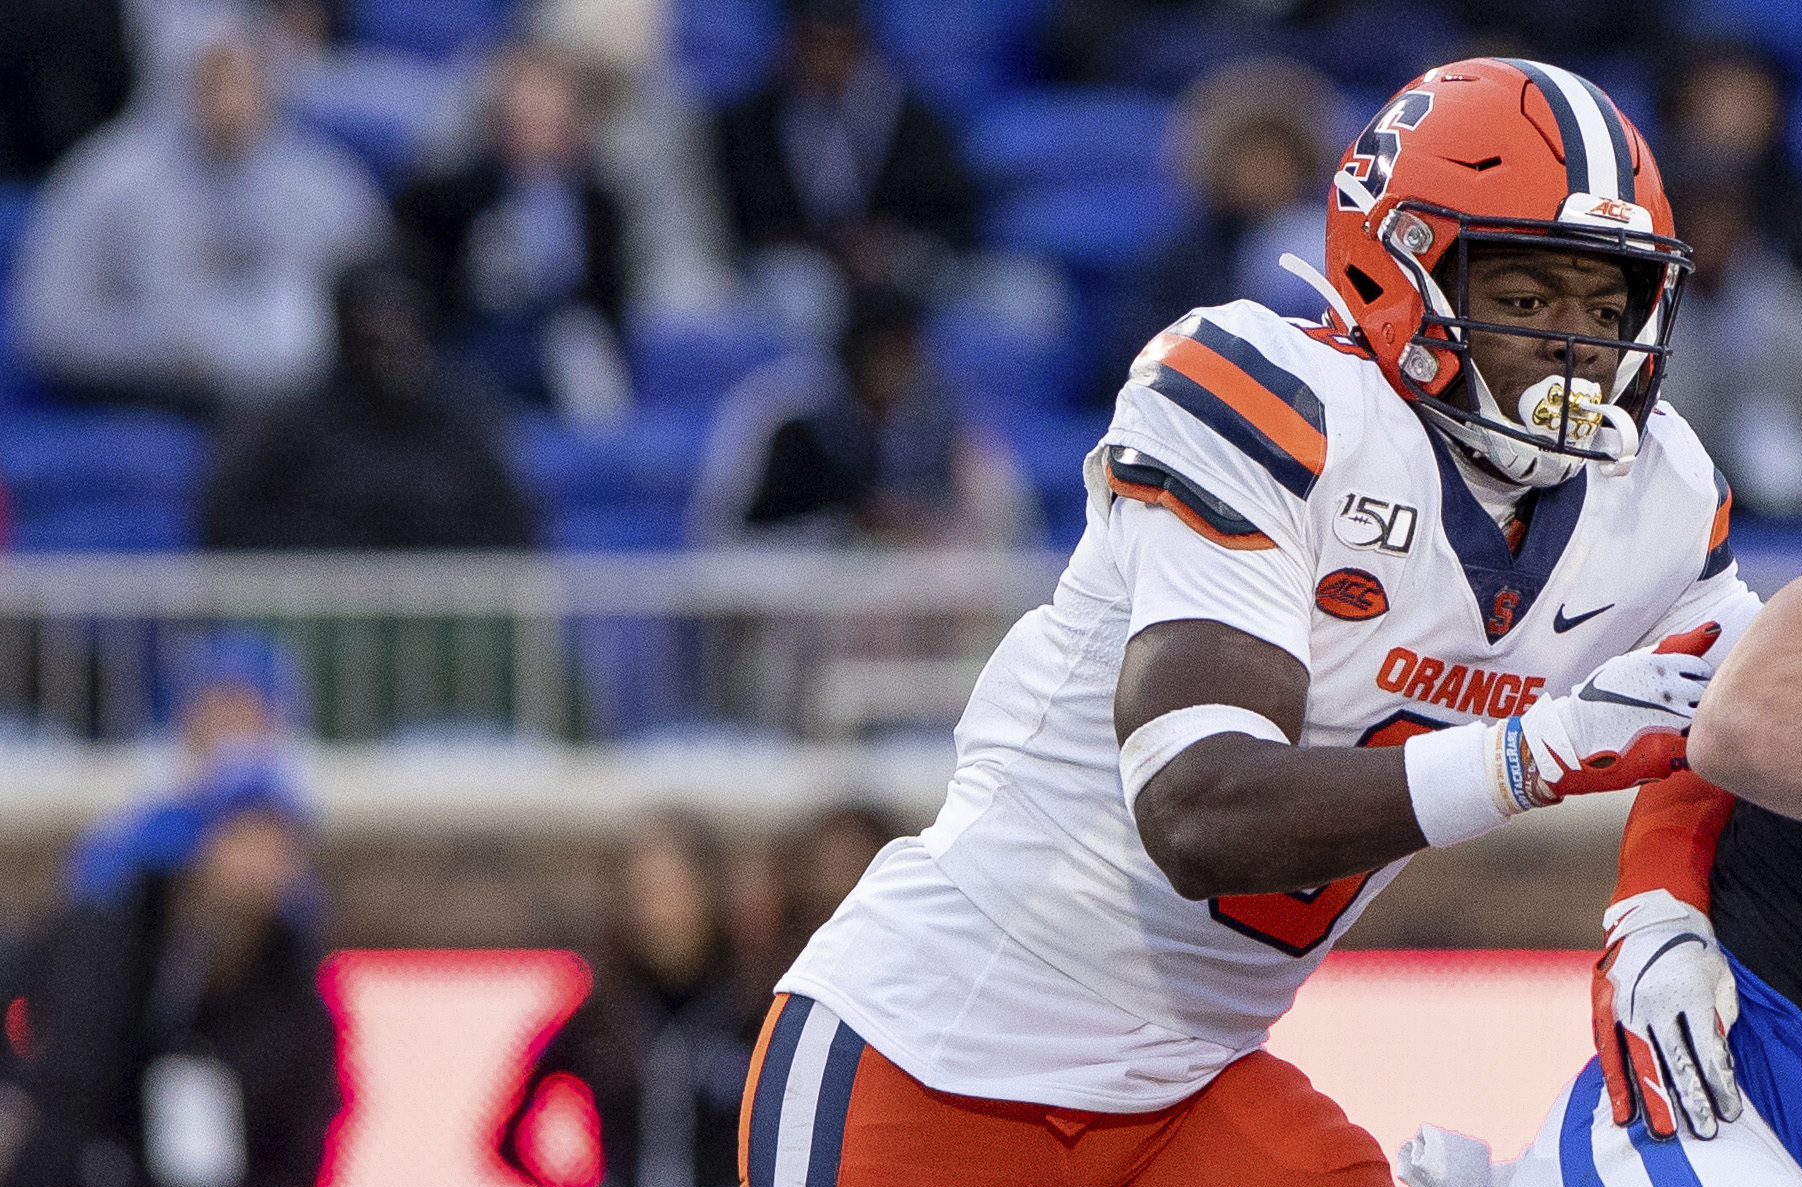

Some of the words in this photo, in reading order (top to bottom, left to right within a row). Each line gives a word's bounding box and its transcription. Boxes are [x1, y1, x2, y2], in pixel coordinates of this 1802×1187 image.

[1587, 197, 1635, 224] ACC
[1338, 492, 1419, 554] 150
[1318, 578, 1384, 612] ACC
[1488, 586, 1522, 635] S
[1376, 646, 1547, 719] ORANGE
